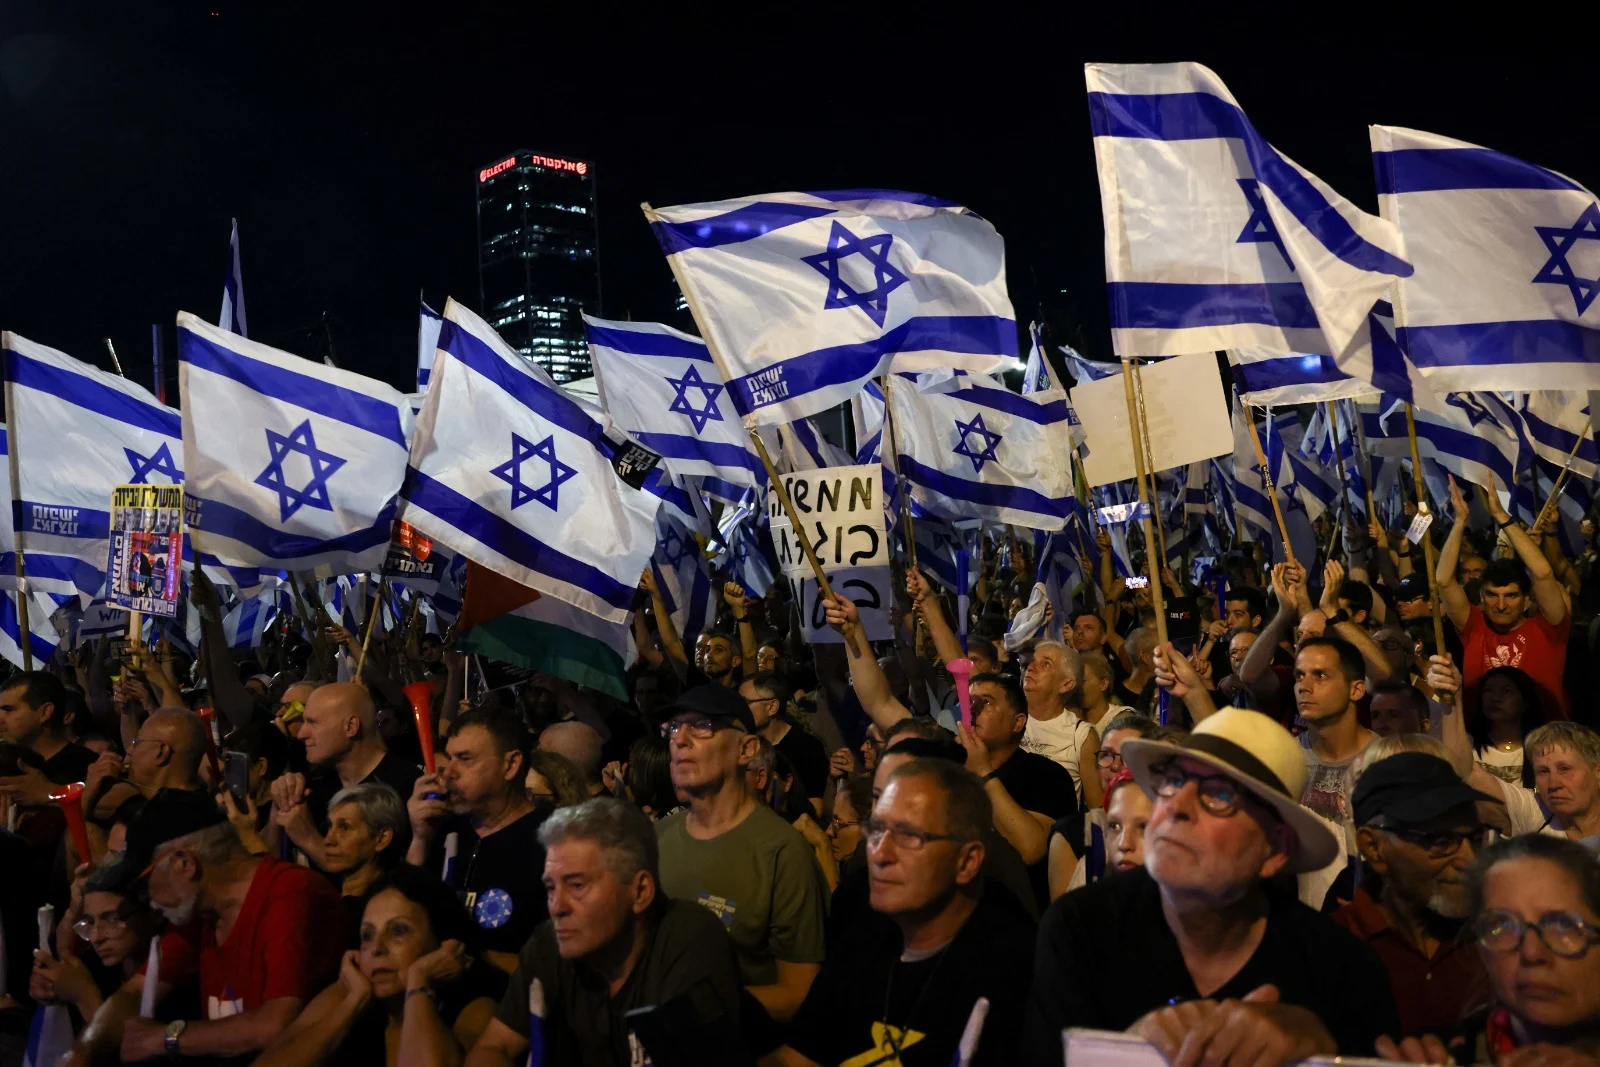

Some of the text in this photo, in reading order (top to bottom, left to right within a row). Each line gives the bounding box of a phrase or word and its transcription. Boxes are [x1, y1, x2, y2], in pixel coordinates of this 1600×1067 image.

[486, 156, 516, 178] ELECTRA
[532, 155, 576, 171] אלקטרה
[115, 488, 140, 507] הביזה
[141, 486, 181, 508] ממשלת
